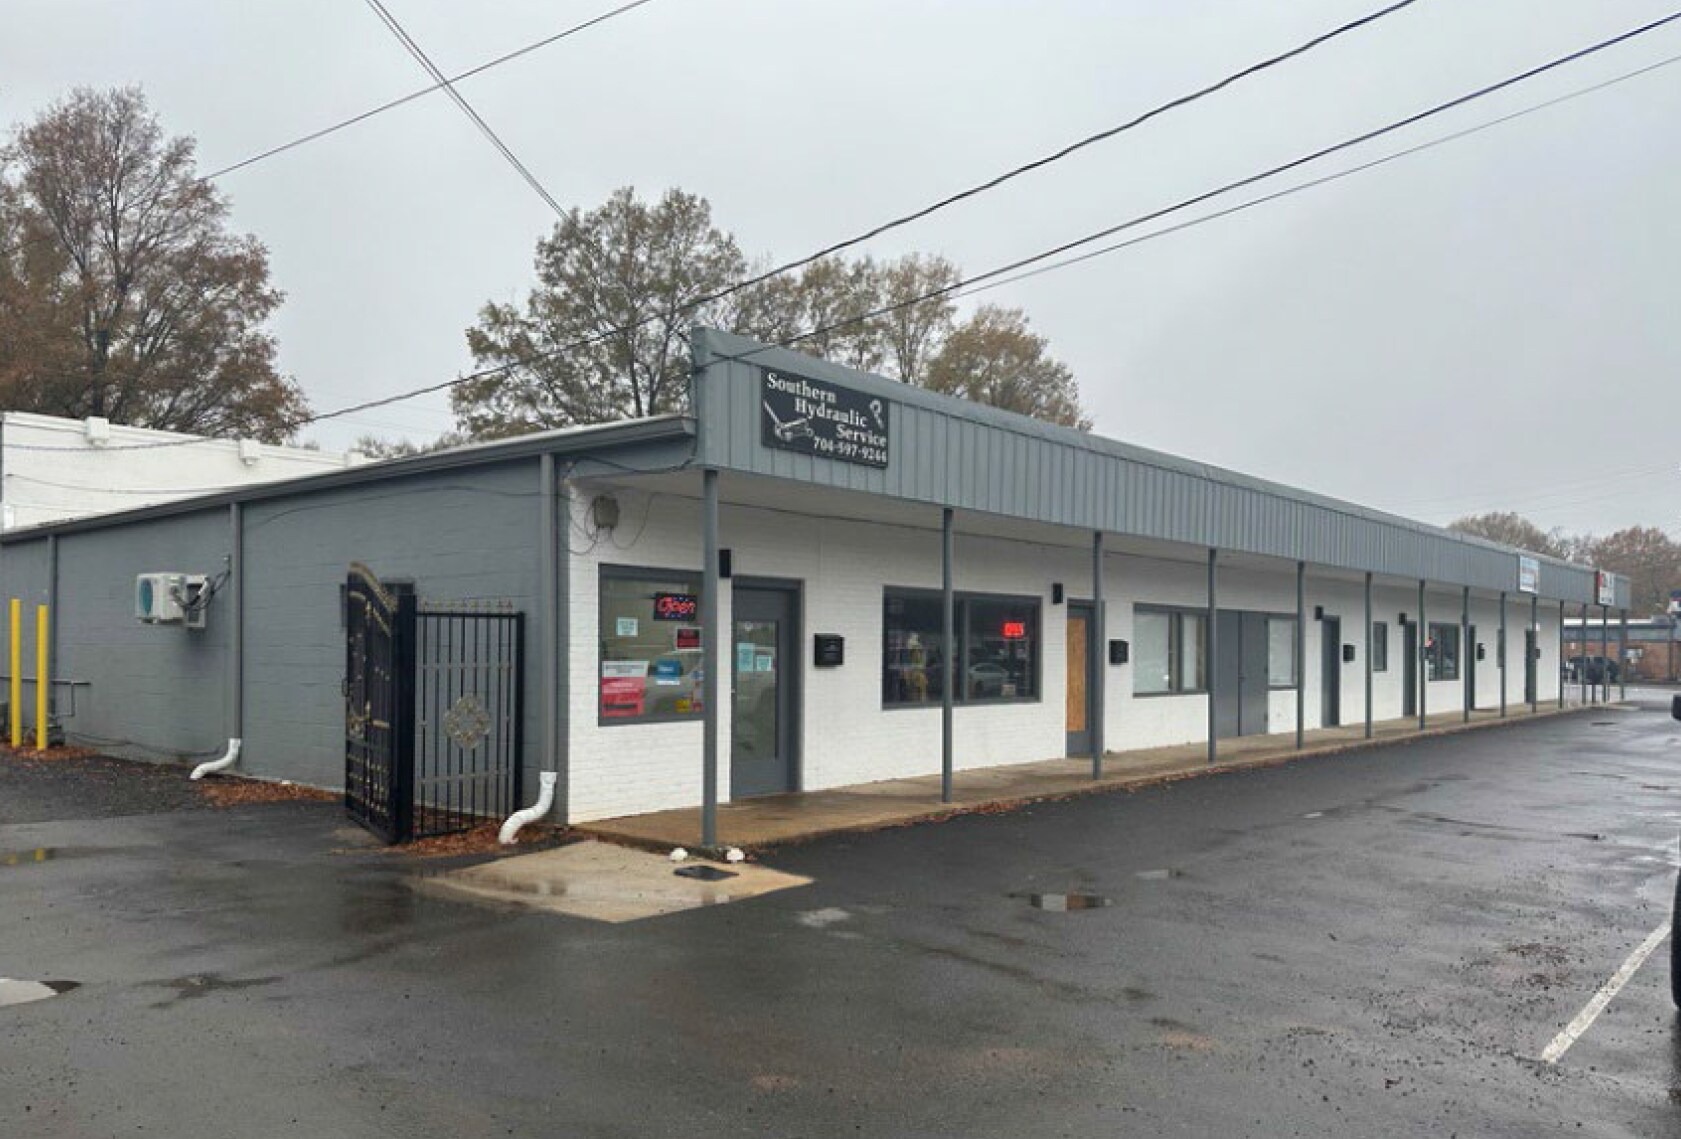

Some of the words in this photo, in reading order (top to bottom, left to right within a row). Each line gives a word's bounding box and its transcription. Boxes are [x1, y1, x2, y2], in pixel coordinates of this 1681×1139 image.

[767, 372, 836, 403] Southern
[795, 398, 867, 427] Hydraulic
[836, 424, 887, 447] Service
